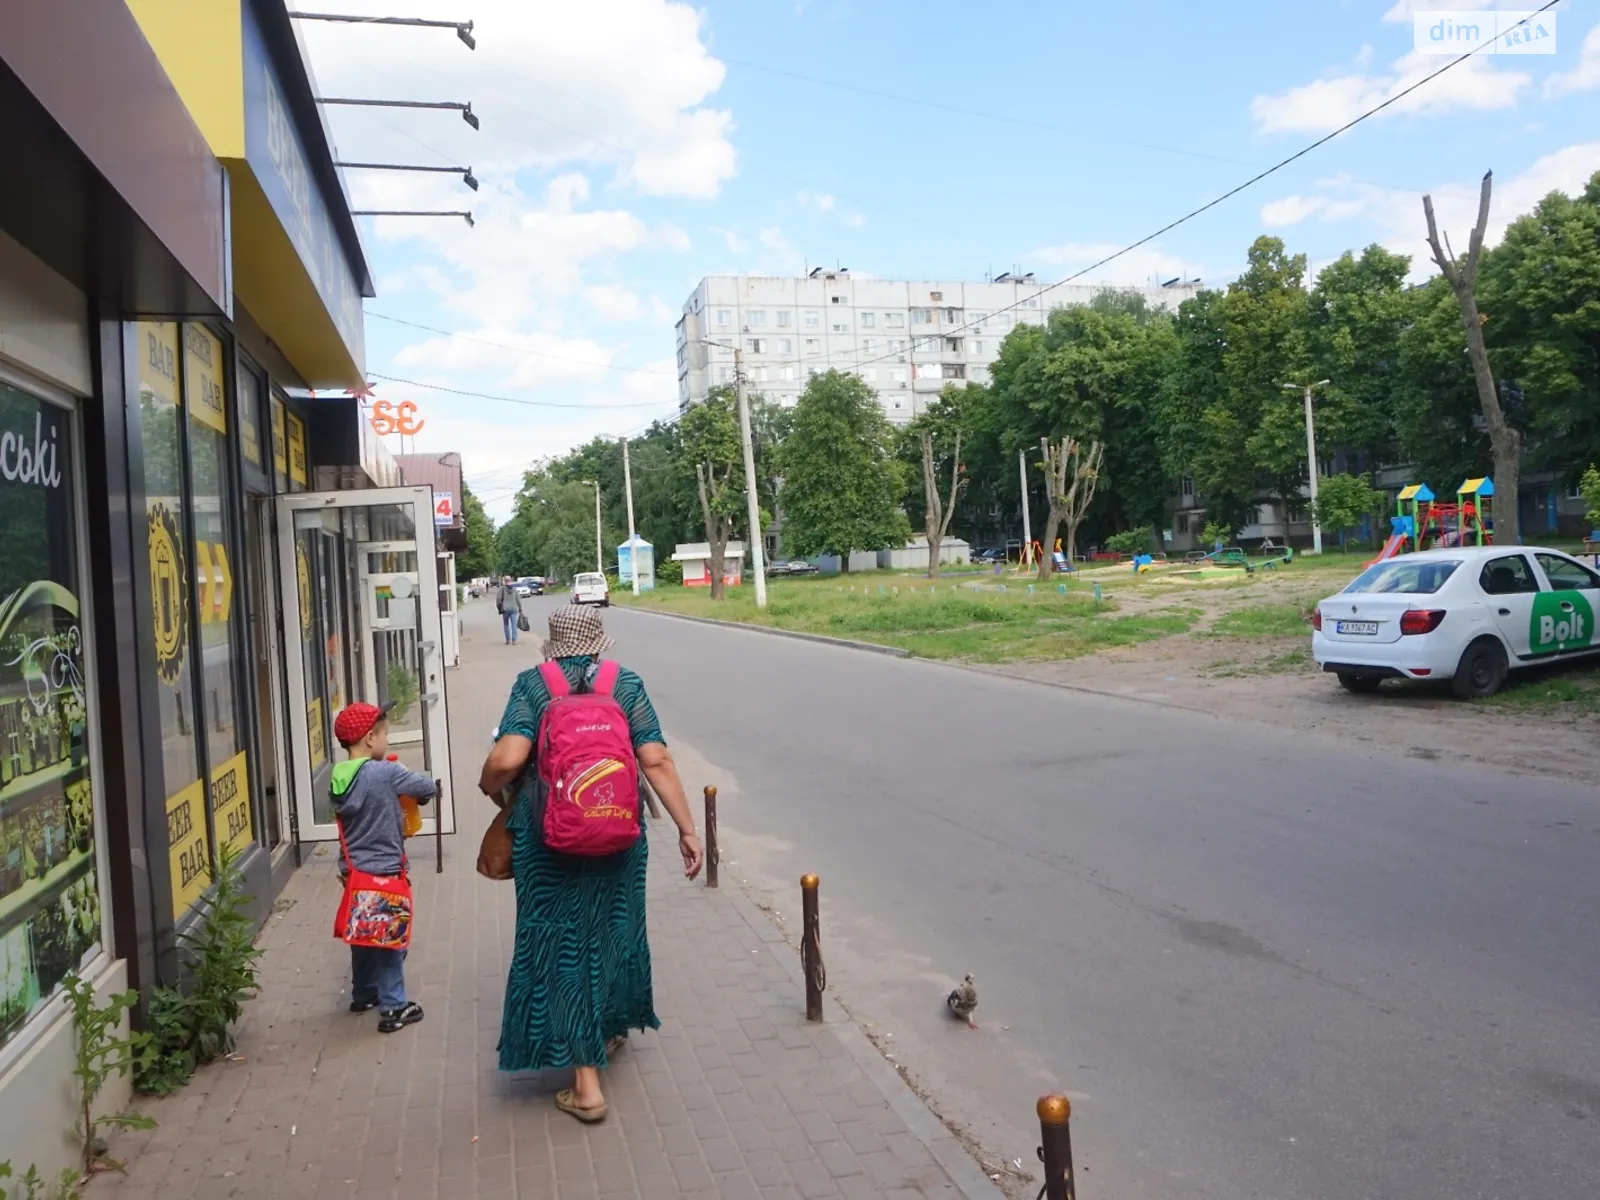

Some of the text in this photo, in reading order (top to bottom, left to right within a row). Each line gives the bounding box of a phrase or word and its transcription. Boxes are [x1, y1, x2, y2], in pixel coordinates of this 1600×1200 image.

[148, 330, 176, 383] BAR
[200, 371, 222, 413] BAR
[436, 499, 452, 516] 4
[1540, 611, 1585, 644] Bolt
[167, 799, 193, 846] EER
[227, 801, 248, 842] BAR
[584, 808, 612, 818] COLOR
[179, 837, 206, 889] BAR
